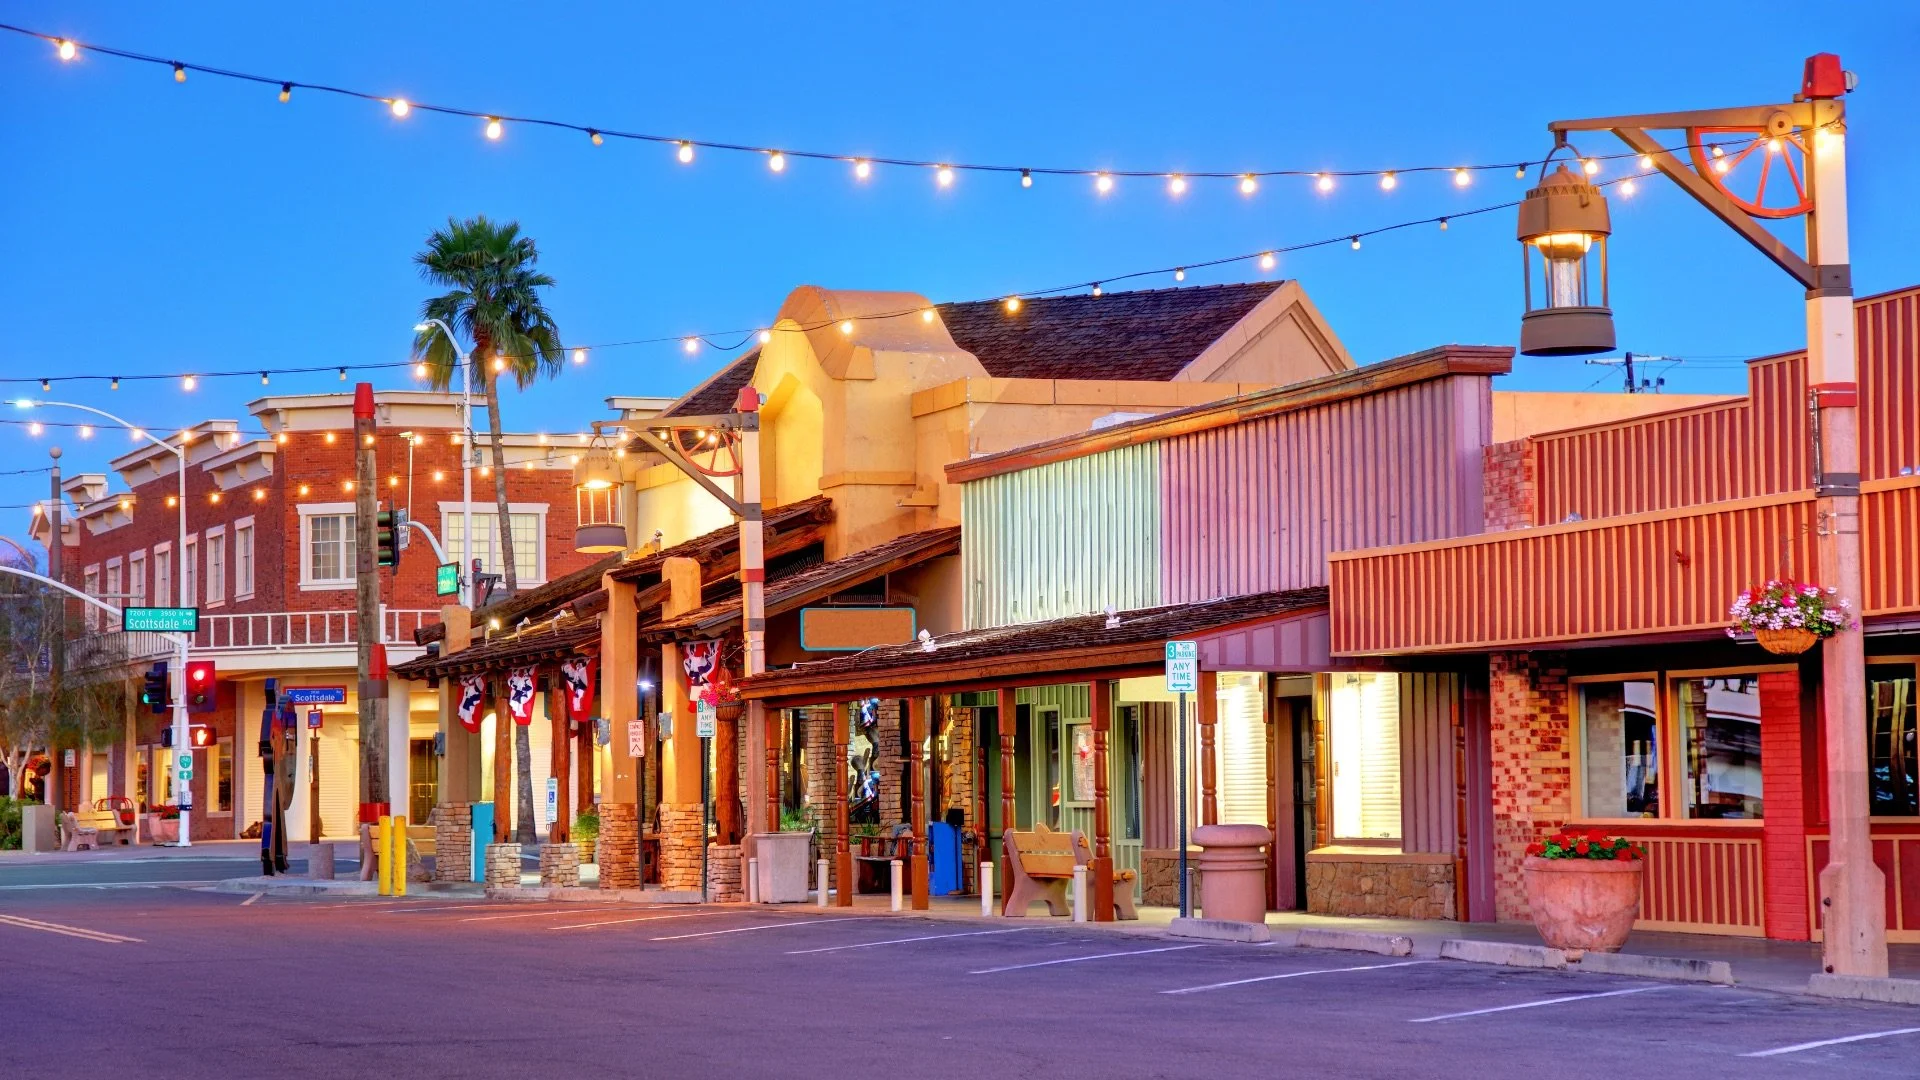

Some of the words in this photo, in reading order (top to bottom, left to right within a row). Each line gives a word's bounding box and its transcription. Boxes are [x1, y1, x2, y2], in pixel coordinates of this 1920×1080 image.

[129, 618, 180, 629] Scottsdale
[182, 618, 193, 626] Rd
[1168, 645, 1175, 657] 3
[1172, 662, 1190, 671] ANY
[1172, 672, 1191, 680] TIME
[698, 701, 703, 711] 3
